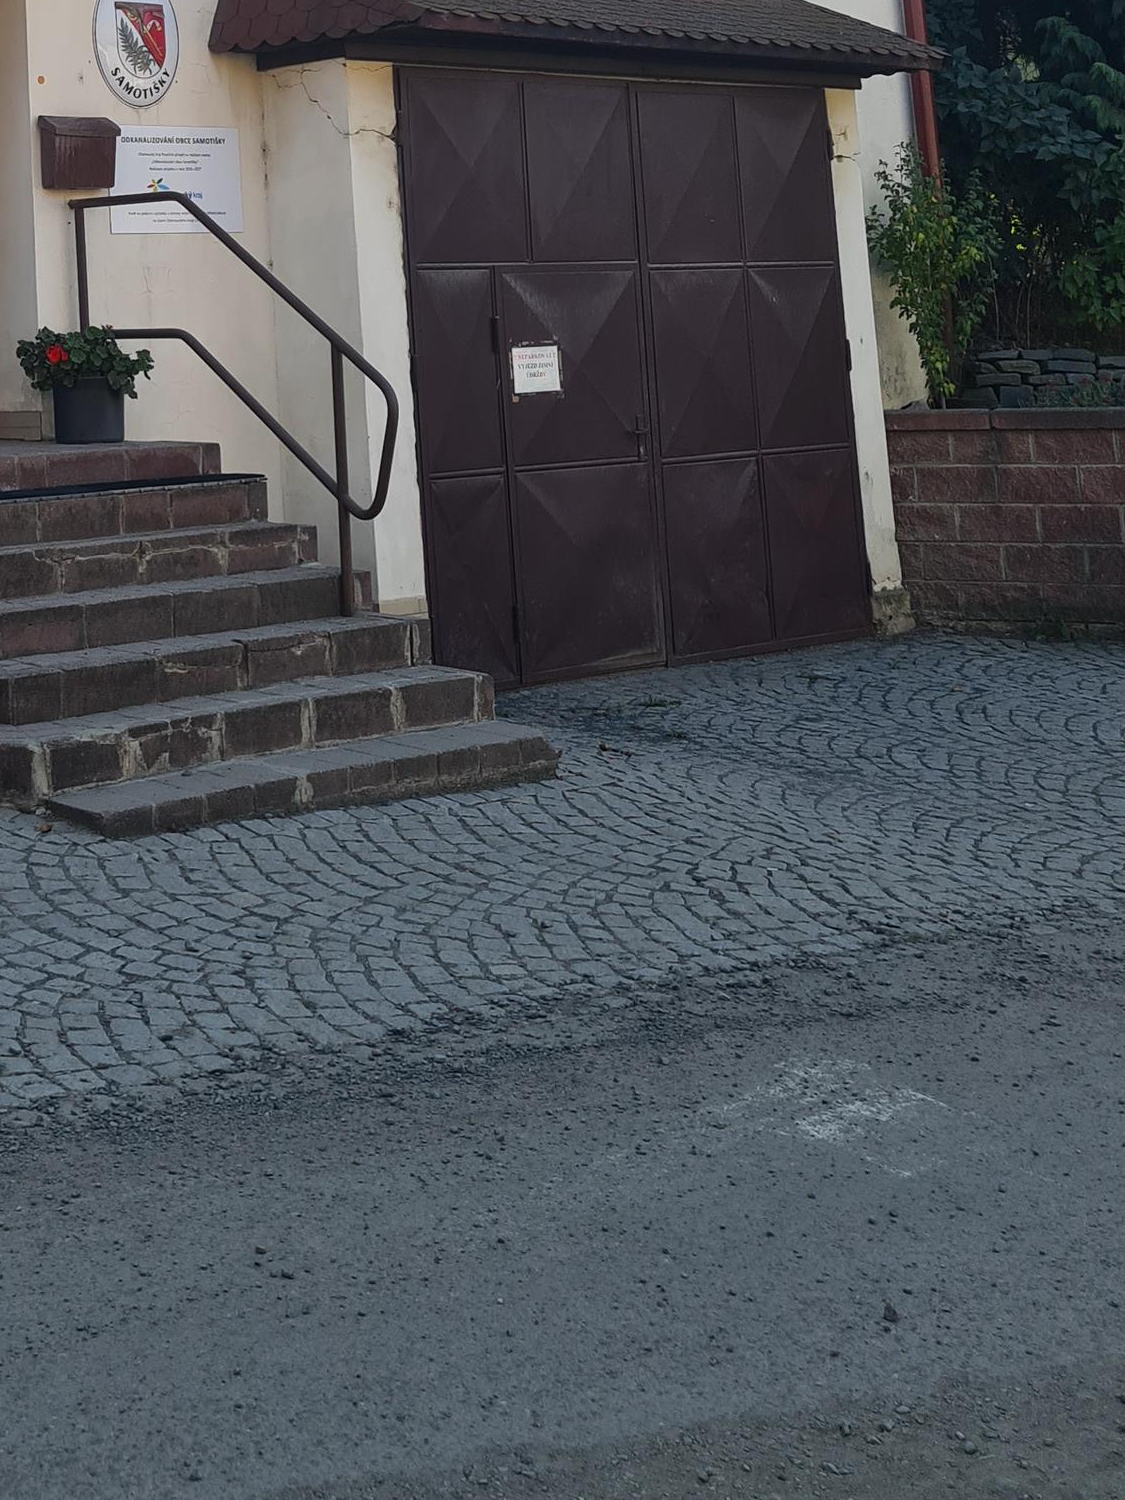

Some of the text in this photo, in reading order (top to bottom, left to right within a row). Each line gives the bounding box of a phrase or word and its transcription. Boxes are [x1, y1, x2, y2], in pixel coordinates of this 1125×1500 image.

[110, 67, 171, 99] SAMOTIŠKY
[120, 136, 174, 144] ODKANALIZOVÁNÍ
[192, 136, 226, 145] SAMOTIŠKY
